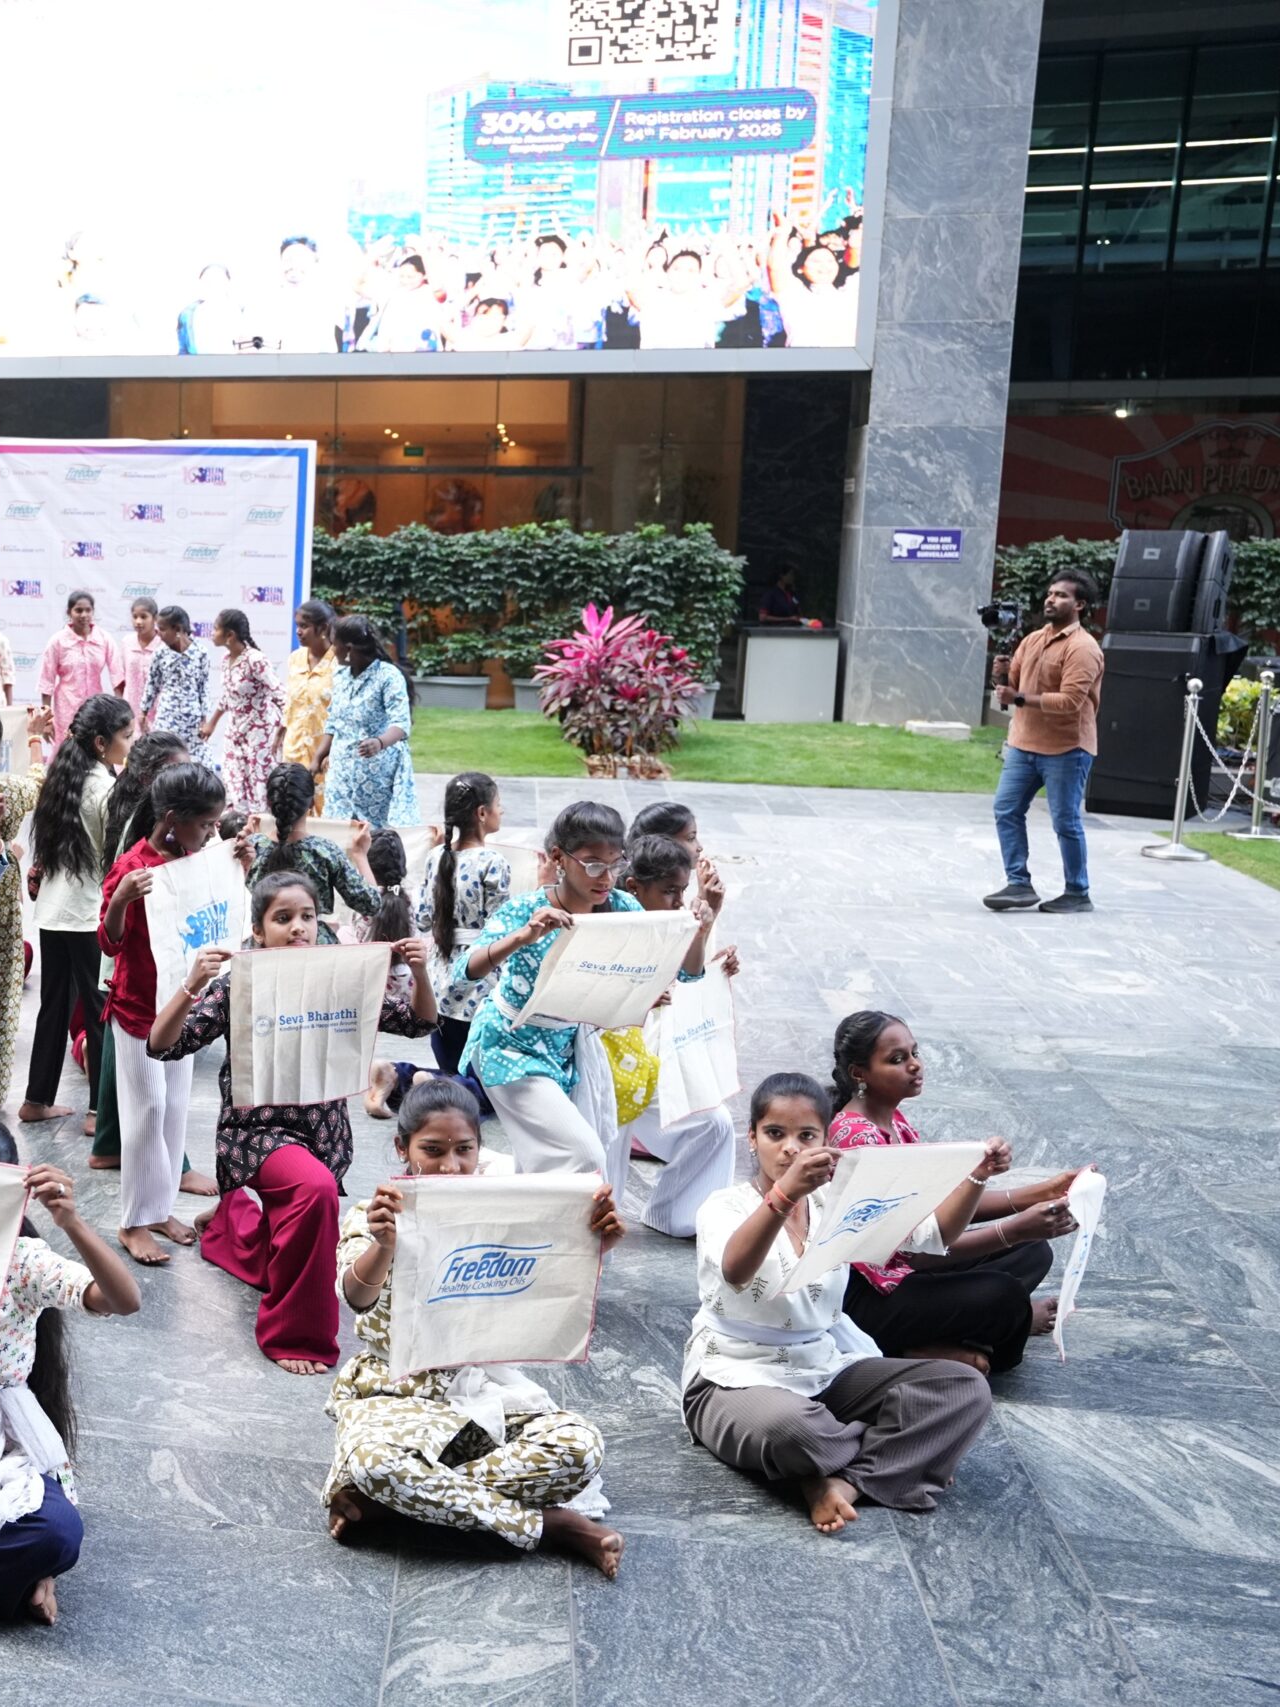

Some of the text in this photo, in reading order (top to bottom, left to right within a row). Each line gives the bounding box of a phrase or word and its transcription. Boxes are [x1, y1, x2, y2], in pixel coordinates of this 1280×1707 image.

[480, 110, 597, 135] 30% OFF
[624, 105, 808, 127] Registration closes by
[658, 125, 735, 142] February
[738, 122, 783, 139] 2026
[1126, 466, 1193, 500] BAAN
[196, 900, 228, 926] RUN
[579, 960, 658, 974] Seva Bharathi
[279, 1008, 358, 1026] Seva Bharathi
[441, 1251, 537, 1284] Freedom
[437, 1277, 526, 1294] Healthy Cooking Oils
